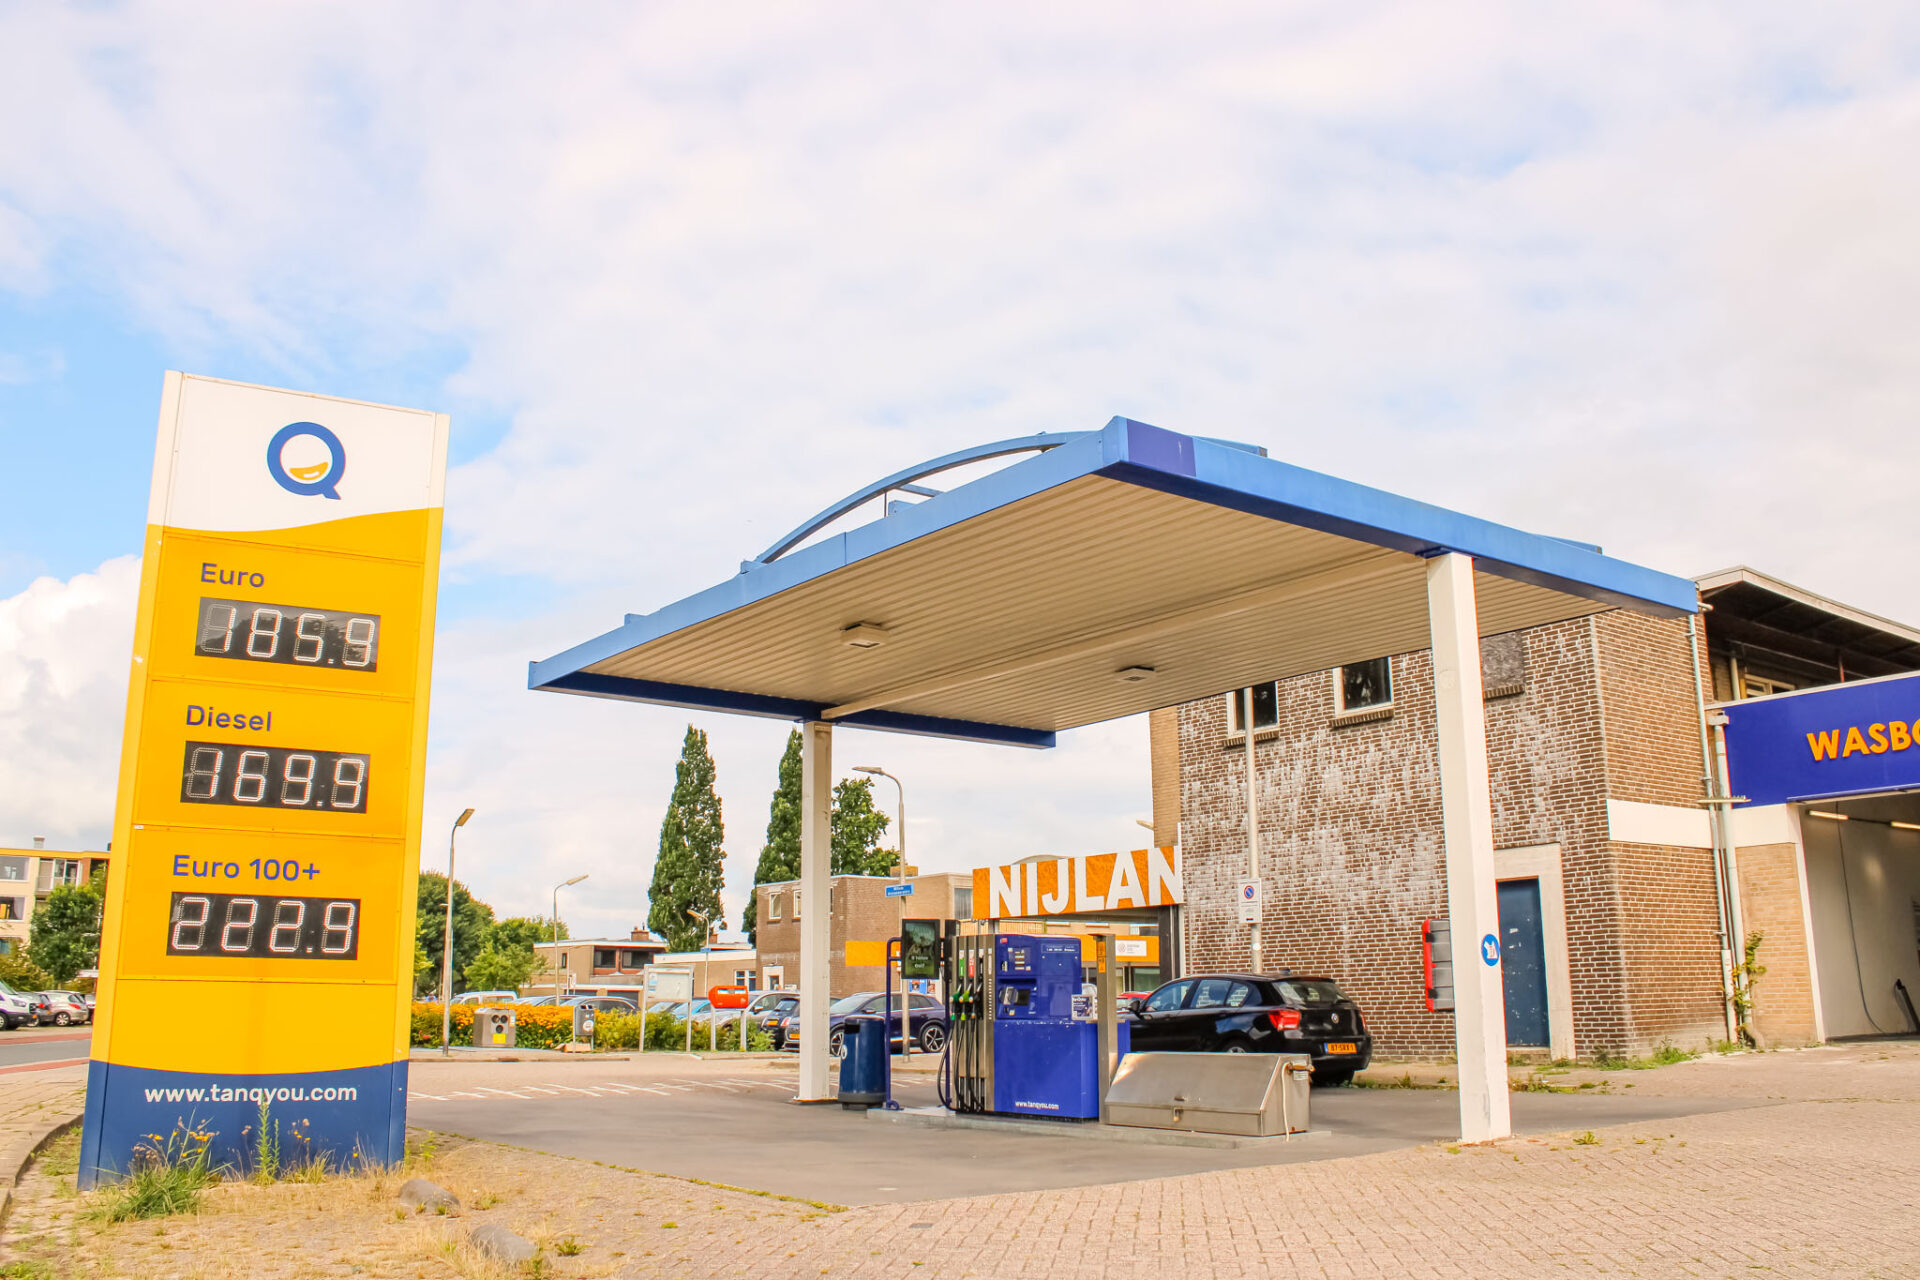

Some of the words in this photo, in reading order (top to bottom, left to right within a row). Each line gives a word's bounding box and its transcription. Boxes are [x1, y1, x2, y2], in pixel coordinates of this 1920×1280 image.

[200, 562, 265, 588] Euro
[222, 606, 376, 668] 185.9
[185, 704, 272, 732] Diesel
[209, 749, 365, 809] 169.9
[172, 854, 240, 879] Euro
[249, 858, 321, 882] 100+
[989, 846, 1184, 919] NIJLAN
[172, 896, 356, 954] 222.9
[144, 1083, 358, 1107] www.tanqyou.com
